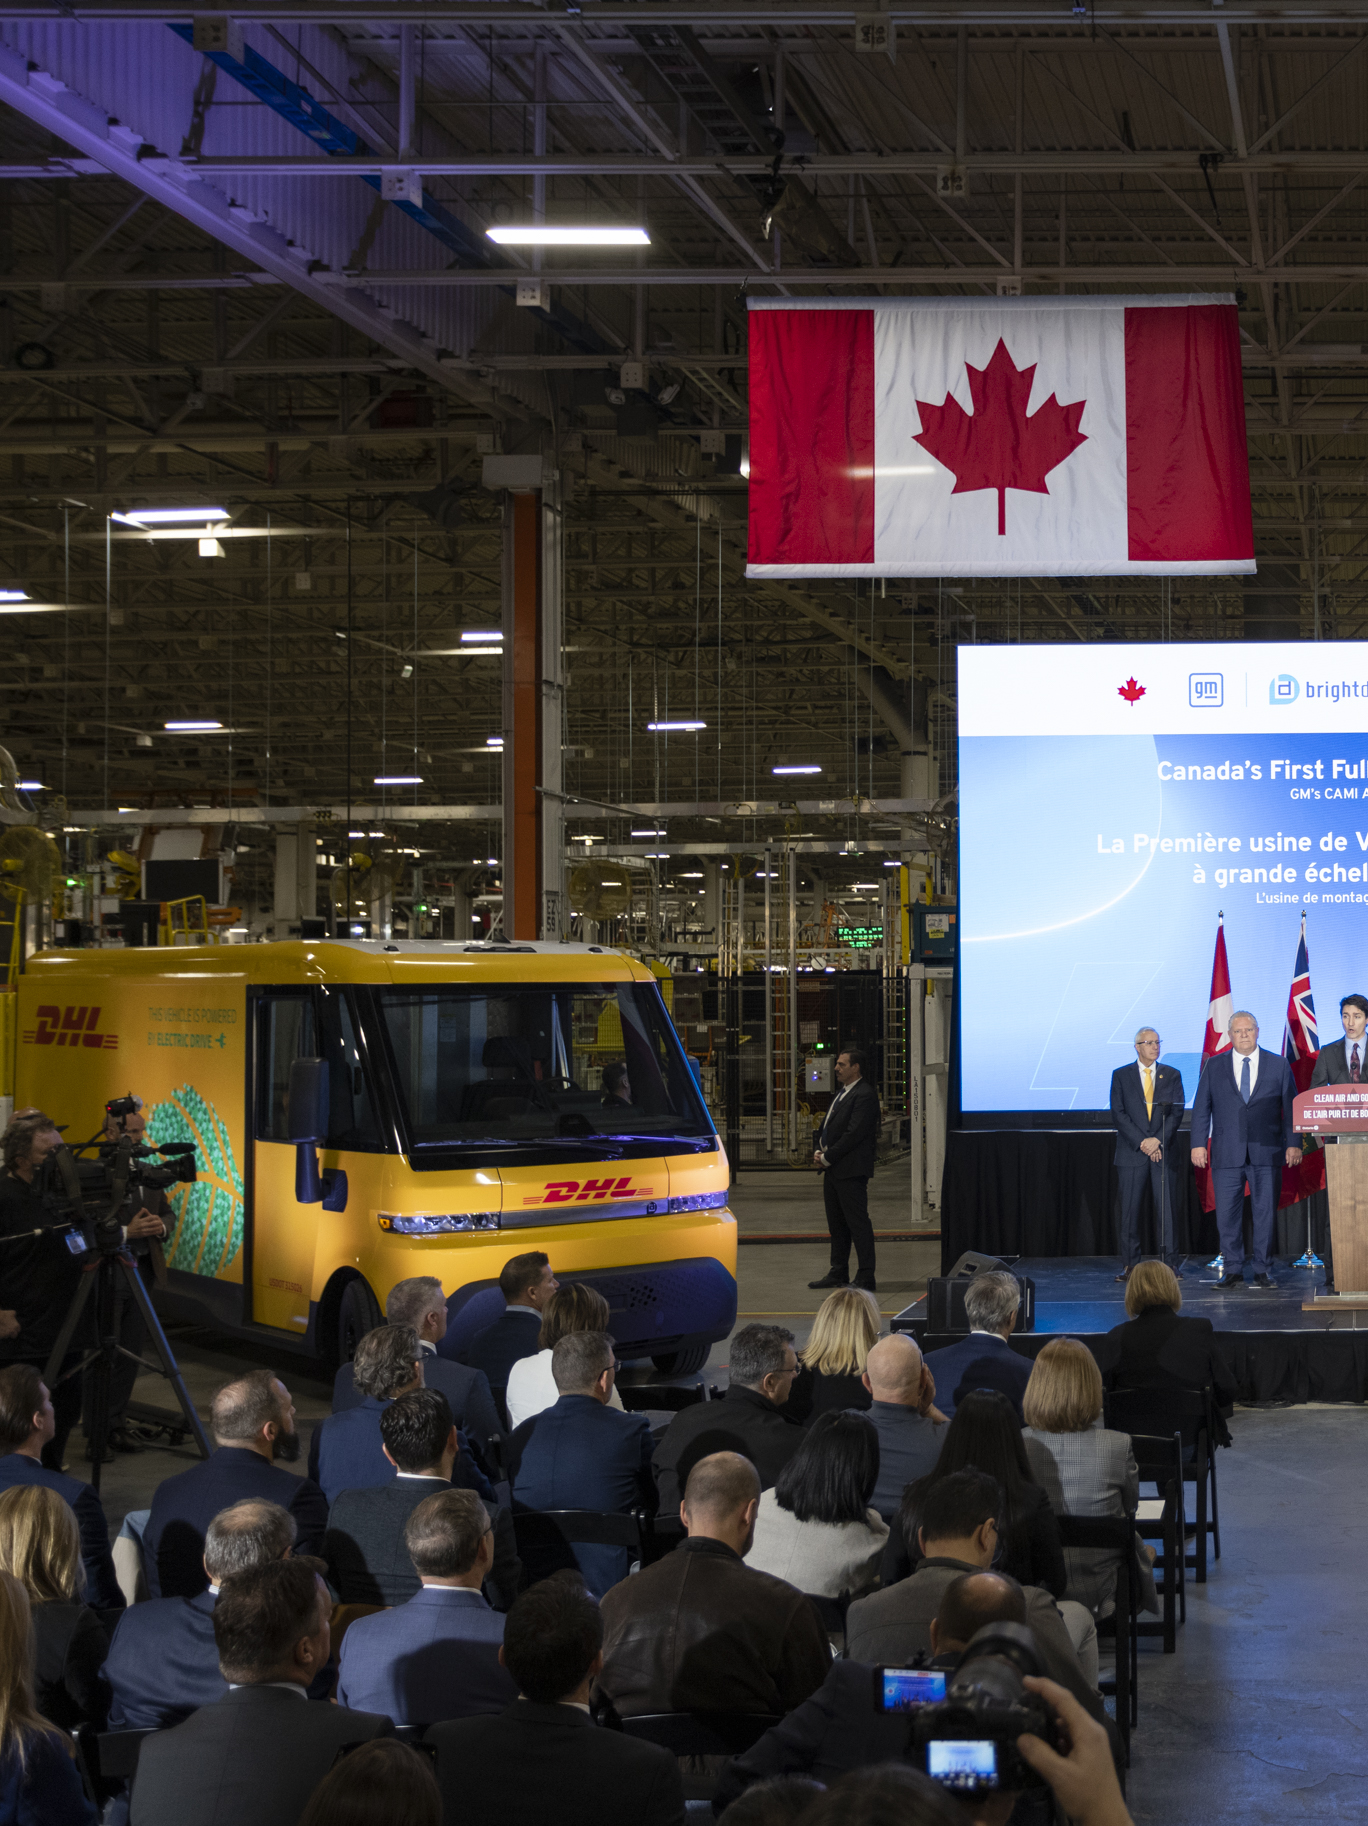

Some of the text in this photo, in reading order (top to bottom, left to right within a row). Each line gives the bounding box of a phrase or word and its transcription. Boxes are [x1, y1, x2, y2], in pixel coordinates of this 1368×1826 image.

[1195, 681, 1218, 699] gm
[1158, 760, 1262, 780] Canada’s
[1271, 760, 1324, 779] First
[1290, 788, 1321, 799] GM’s
[1325, 788, 1358, 799] CAMI
[1098, 834, 1124, 853] La
[1134, 832, 1241, 853] Première
[1250, 832, 1311, 852] usine
[1320, 832, 1347, 851] de
[1193, 864, 1205, 883] à
[1215, 864, 1297, 888] grande
[1257, 892, 1299, 903] L’usine
[1303, 892, 1318, 903] de
[547, 916, 556, 932] 59
[148, 1007, 237, 1024] THIS VEHICLE IS POWERED
[35, 1005, 104, 1049] DHL
[157, 1033, 189, 1049] ELECTRIC
[1314, 1094, 1335, 1103] CLEAN
[1335, 1094, 1346, 1103] AIR
[1346, 1094, 1360, 1102] AND
[1303, 1110, 1312, 1119] DE
[1313, 1110, 1328, 1119] L'AIR
[1328, 1110, 1342, 1119] PUR
[1342, 1110, 1350, 1118] ET
[1350, 1110, 1359, 1118] DE
[543, 1177, 638, 1203] DHL
